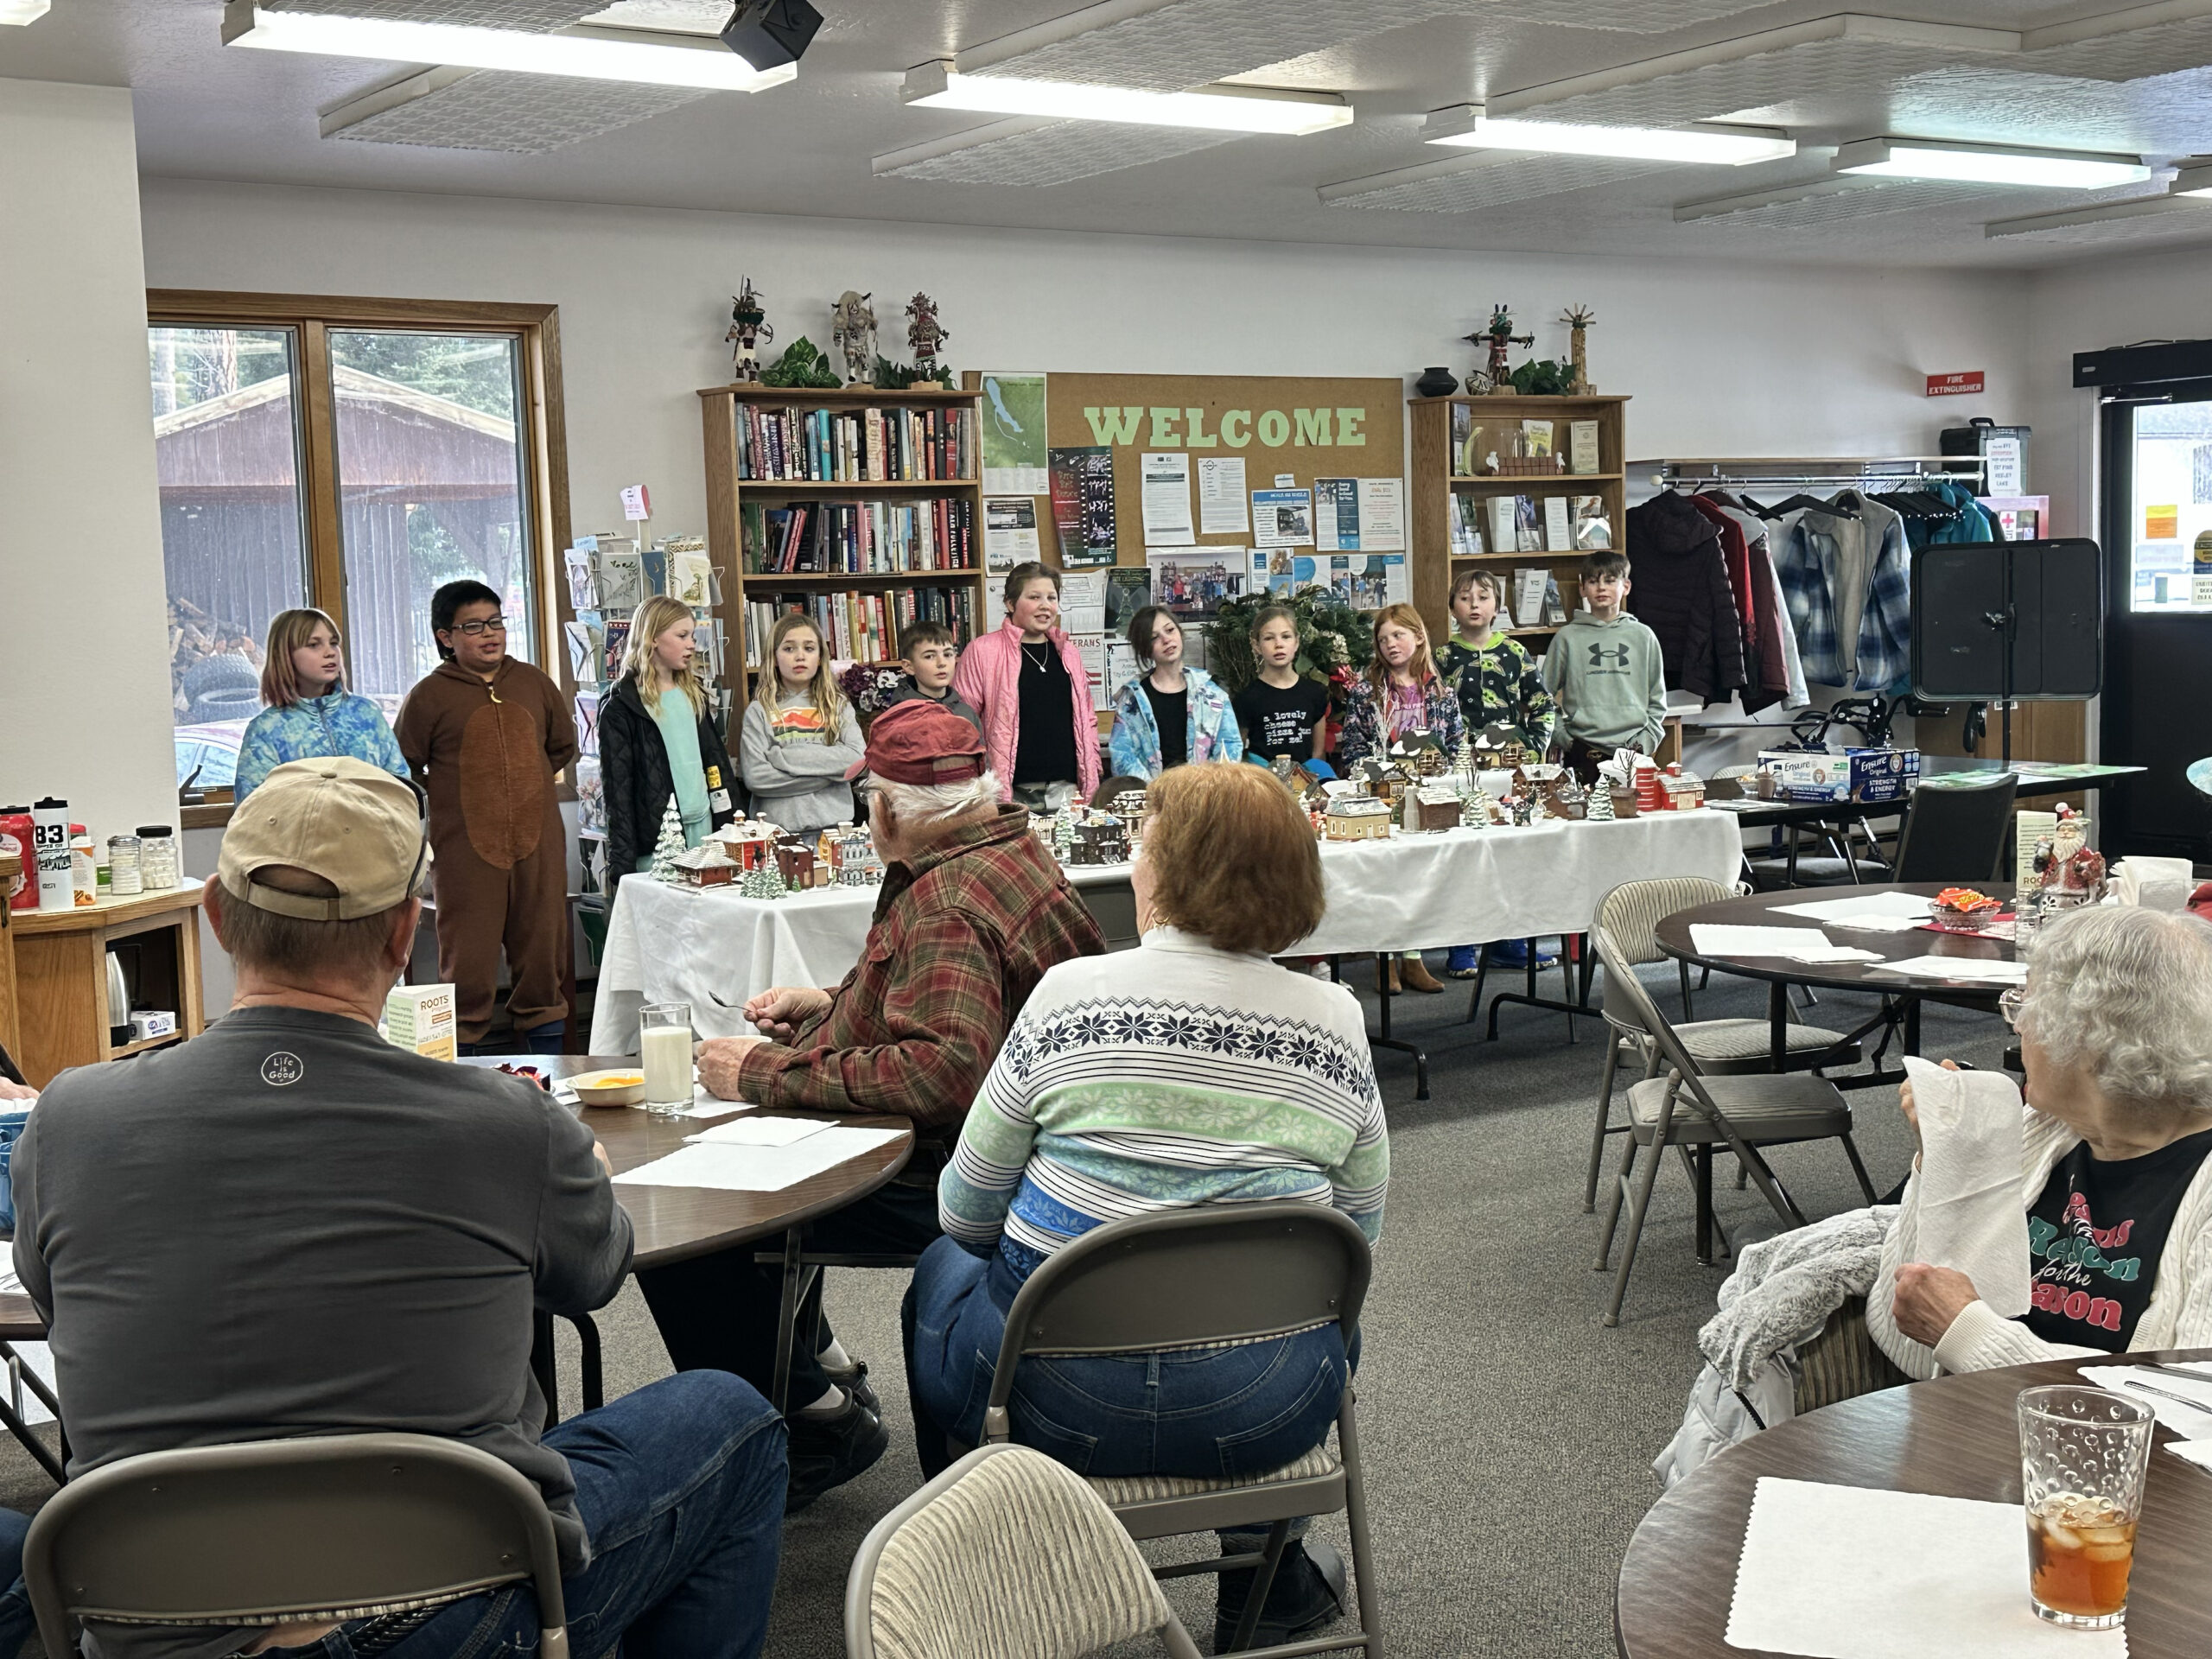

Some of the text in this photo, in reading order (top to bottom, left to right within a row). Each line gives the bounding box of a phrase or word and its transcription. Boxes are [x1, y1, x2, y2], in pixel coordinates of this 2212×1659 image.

[1947, 375, 1964, 384] FIRE
[1928, 383, 1982, 395] EXTINGUISHER
[1084, 406, 1366, 448] WELCOME
[1274, 710, 1307, 720] lovely
[1784, 760, 1811, 771] Ensure
[1861, 756, 1887, 772] Ensure
[35, 824, 64, 844] 83
[420, 995, 449, 1010] ROOTS
[274, 1057, 294, 1066] Life
[269, 1071, 296, 1079] Good
[2031, 1279, 2122, 1332] ason
